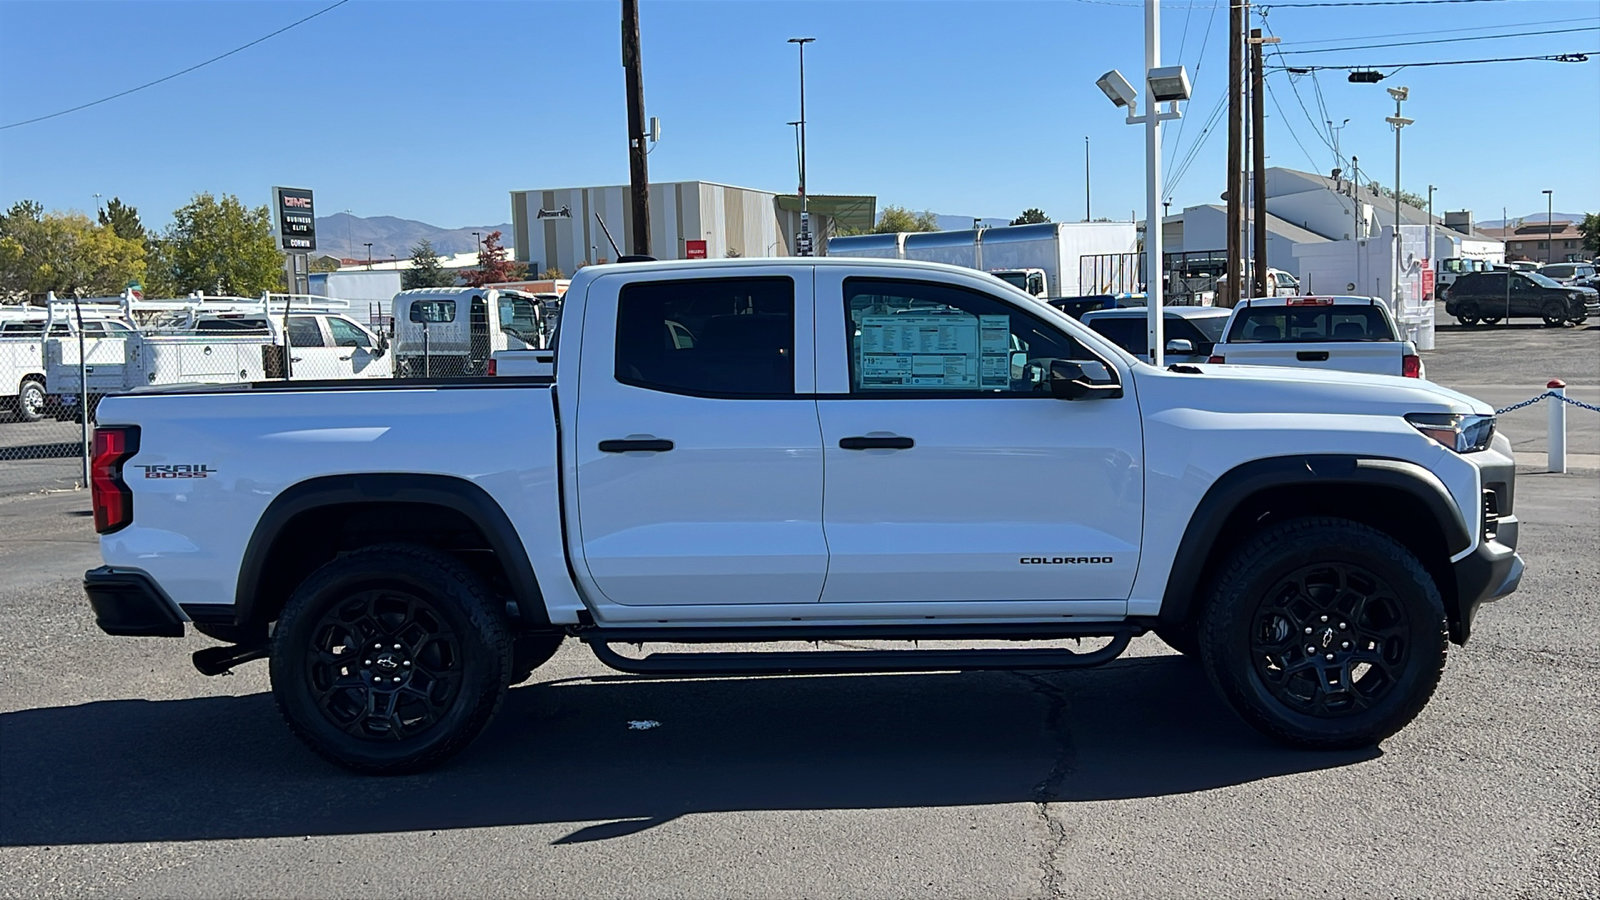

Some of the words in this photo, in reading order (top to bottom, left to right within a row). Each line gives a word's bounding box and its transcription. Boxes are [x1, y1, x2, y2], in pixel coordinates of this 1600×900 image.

[284, 196, 311, 208] GMC
[286, 216, 311, 224] BUSINESS
[290, 239, 310, 247] CORWIN
